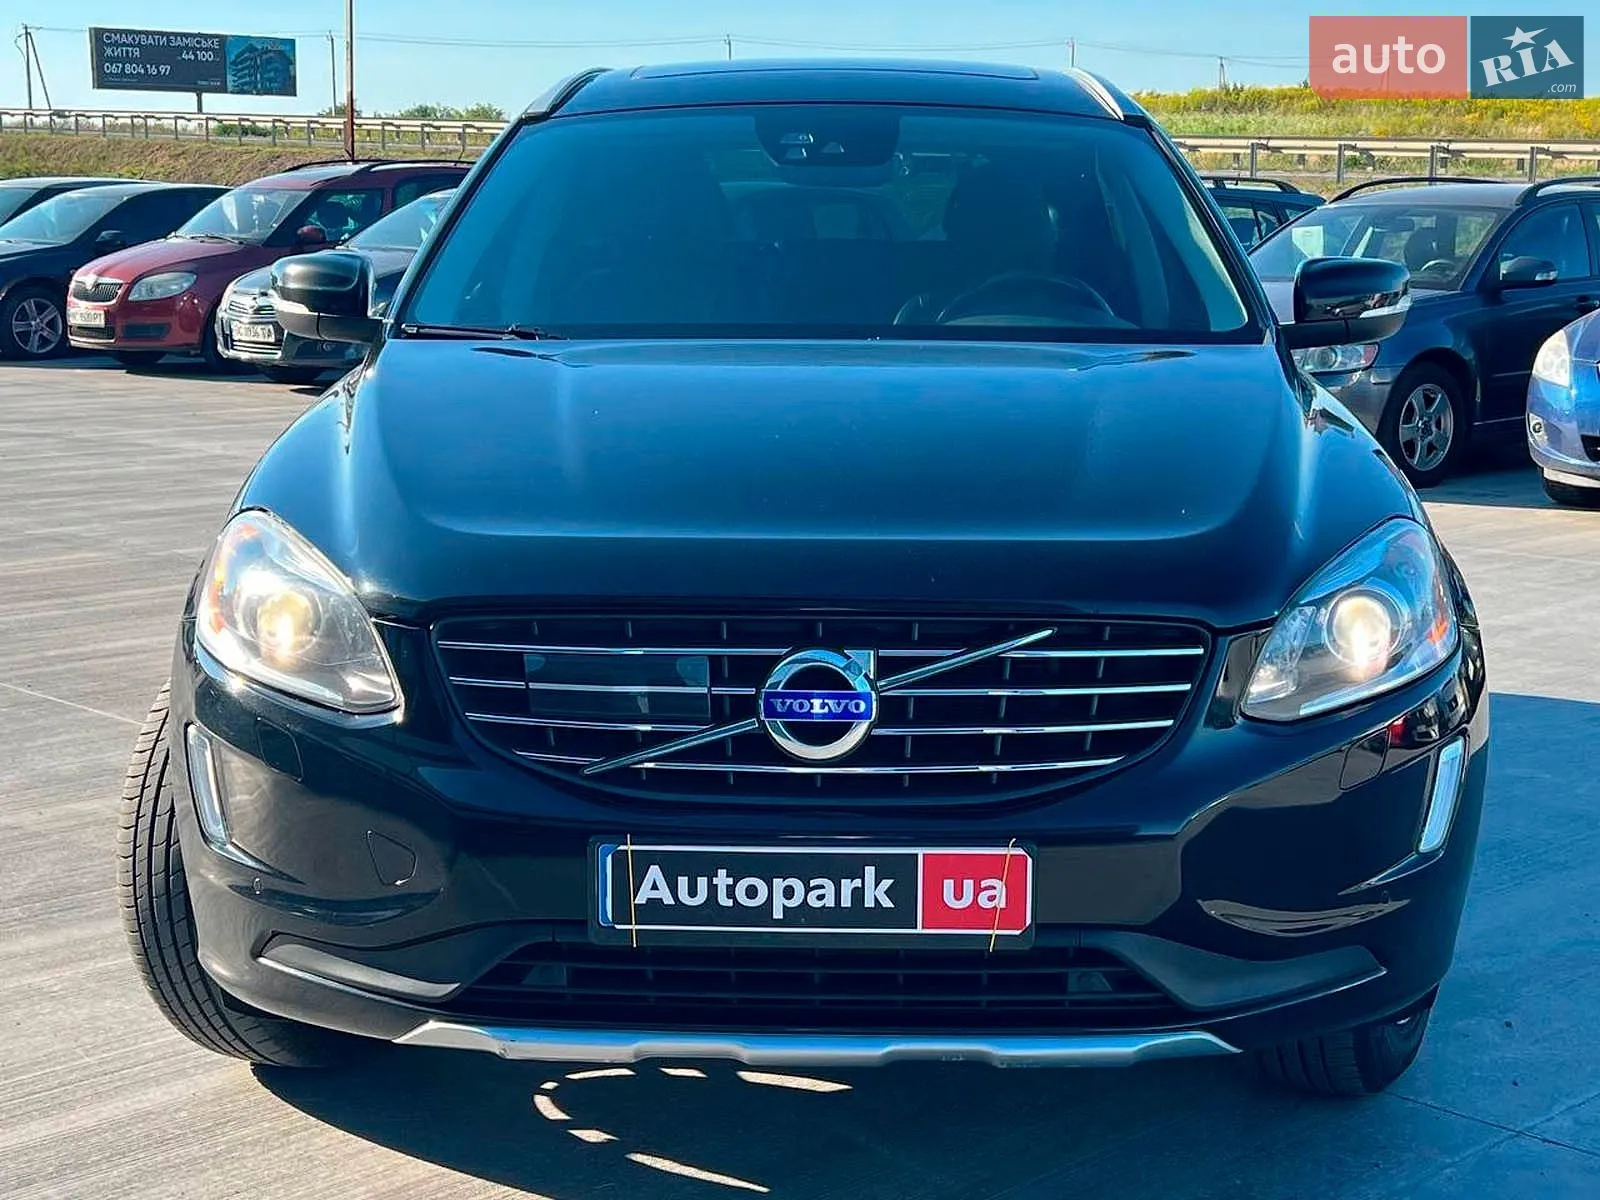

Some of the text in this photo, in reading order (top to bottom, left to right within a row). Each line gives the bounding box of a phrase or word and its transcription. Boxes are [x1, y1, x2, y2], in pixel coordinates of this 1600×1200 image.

[103, 32, 220, 49] СМАКУВАТИ ЗАМІСЬКЕ
[103, 46, 140, 58] ЖИТТЯ
[103, 63, 122, 74] 067
[124, 63, 145, 75] 804
[159, 65, 171, 76] 97
[769, 698, 866, 713] VOLVO
[633, 864, 1007, 919] Autopark ua
